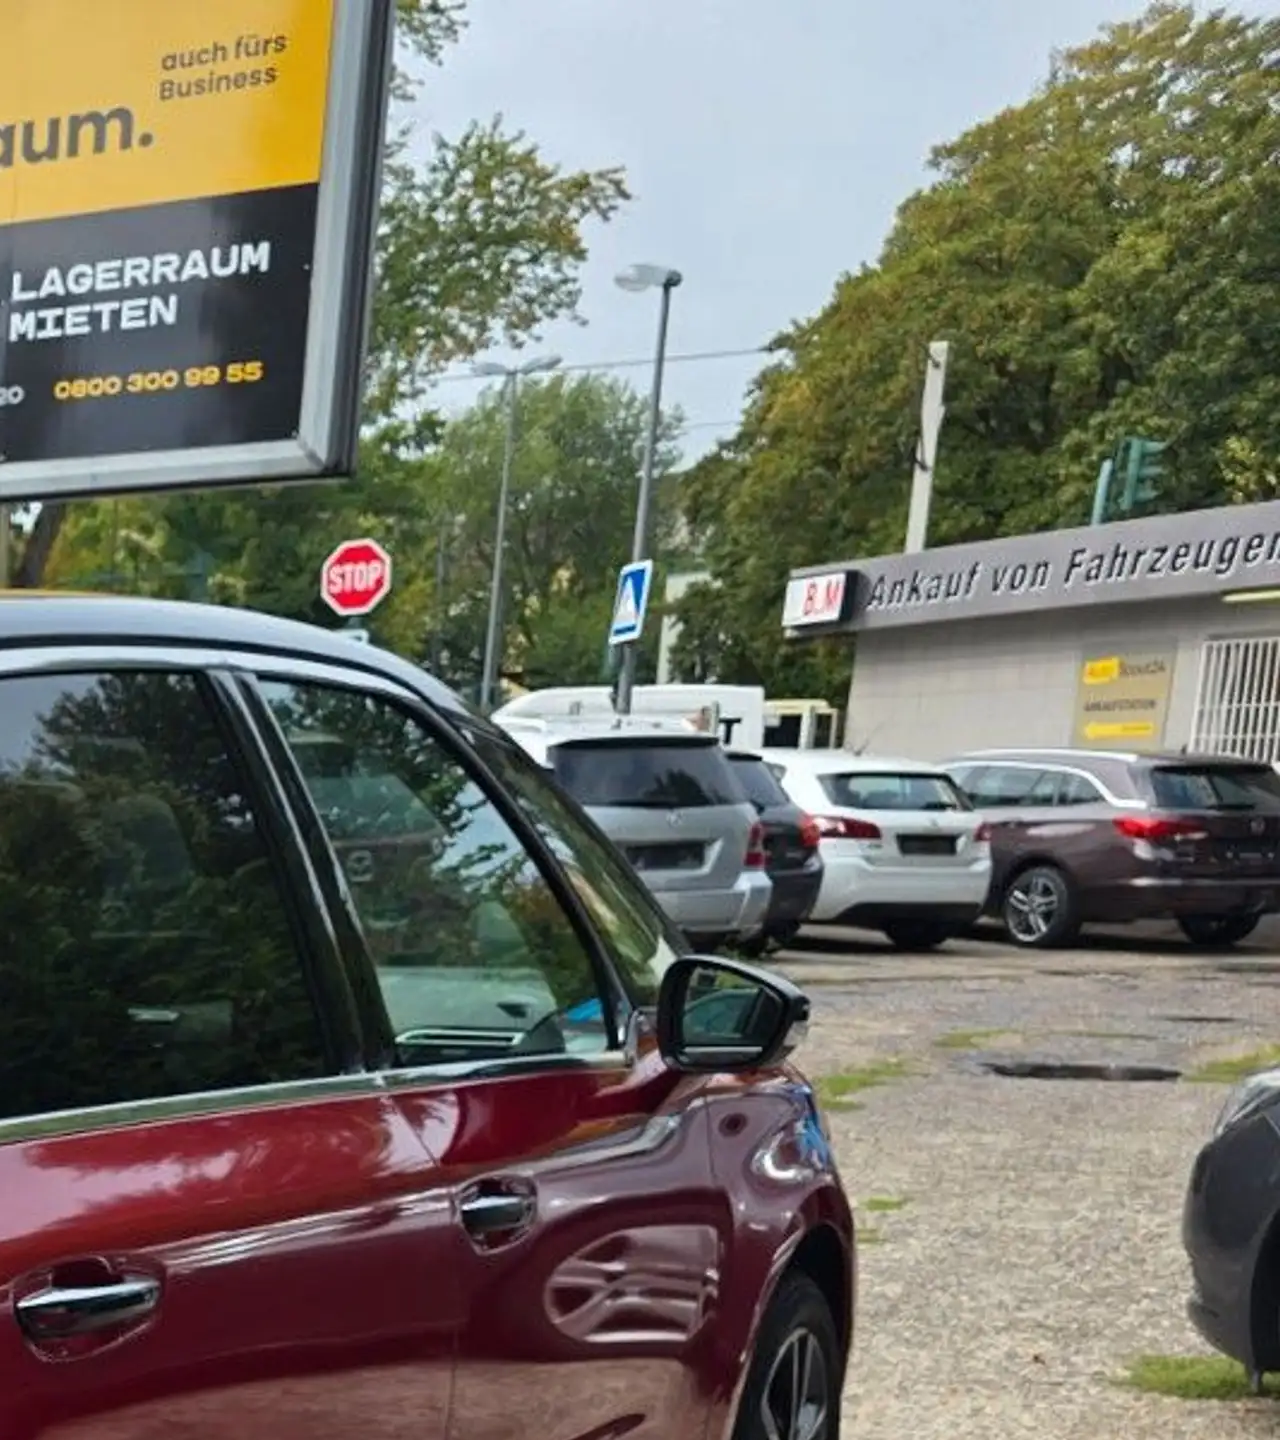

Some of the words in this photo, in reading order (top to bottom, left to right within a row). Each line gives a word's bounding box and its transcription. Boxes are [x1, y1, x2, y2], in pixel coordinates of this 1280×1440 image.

[161, 40, 228, 71] auch
[234, 33, 288, 59] fürs
[159, 64, 278, 102] Business
[11, 241, 272, 302] LAGERRAUM
[8, 294, 178, 343] MIETEN
[54, 378, 121, 401] 0800
[127, 369, 179, 394] 300
[184, 366, 221, 388] 99
[226, 360, 263, 384] 55
[327, 560, 382, 595] STOP
[867, 561, 979, 611] Ankauf
[991, 560, 1049, 596] von
